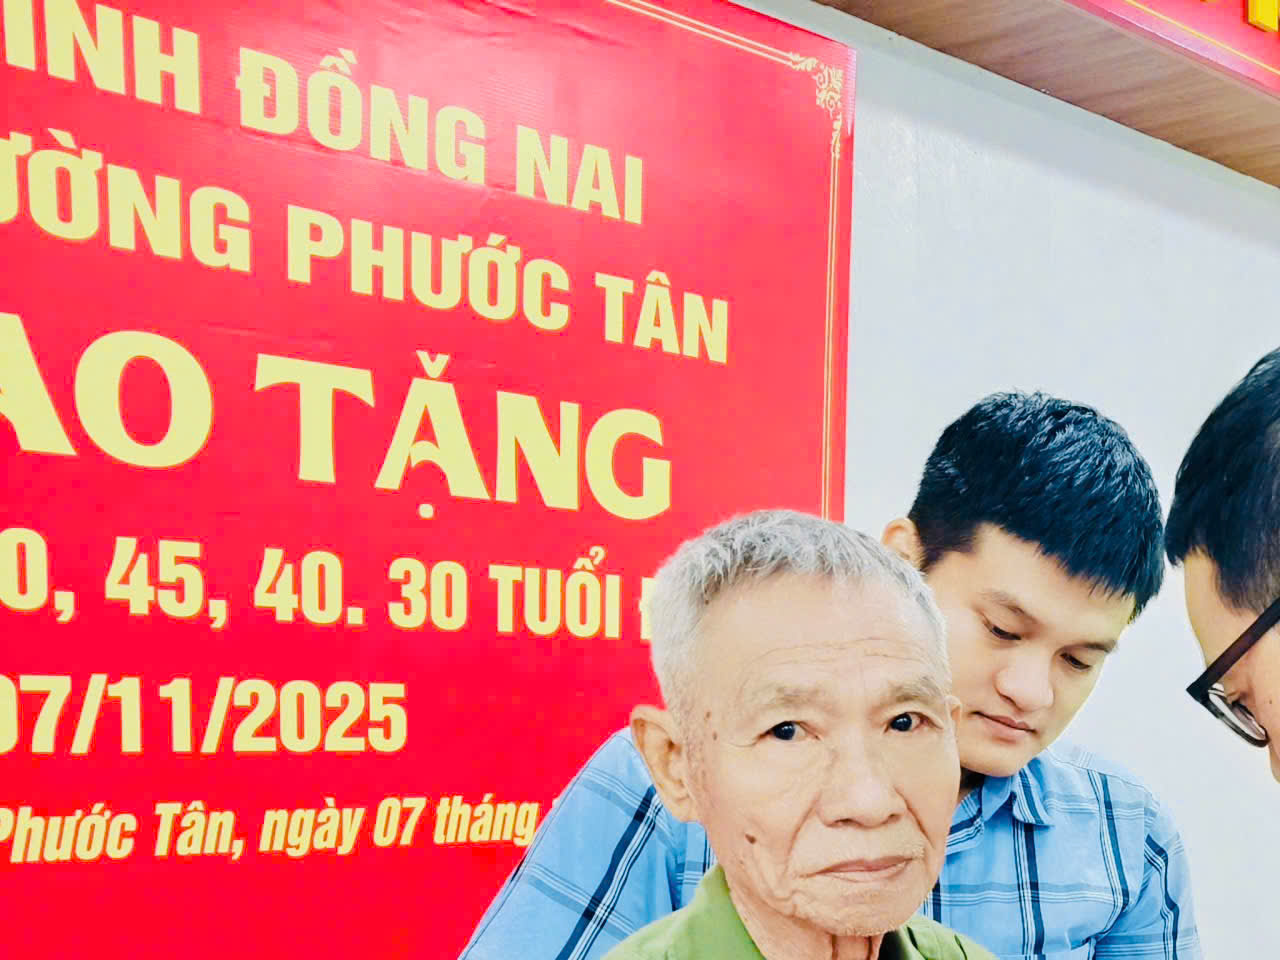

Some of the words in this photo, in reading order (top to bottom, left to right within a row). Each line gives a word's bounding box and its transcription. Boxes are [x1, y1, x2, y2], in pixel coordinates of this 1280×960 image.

[235, 48, 486, 184] ĐỒNG
[515, 124, 644, 225] NAI
[287, 204, 570, 331] PHƯỚC
[594, 269, 728, 364] TÂN
[254, 350, 671, 521] TẶNG
[105, 536, 227, 629] 45,
[254, 547, 364, 629] 40.
[388, 557, 468, 633] 30
[488, 545, 621, 639] TUỔI
[153, 800, 244, 861] Tân,
[258, 797, 366, 857] ngày
[373, 797, 427, 847] 07
[433, 793, 540, 846] tháng
